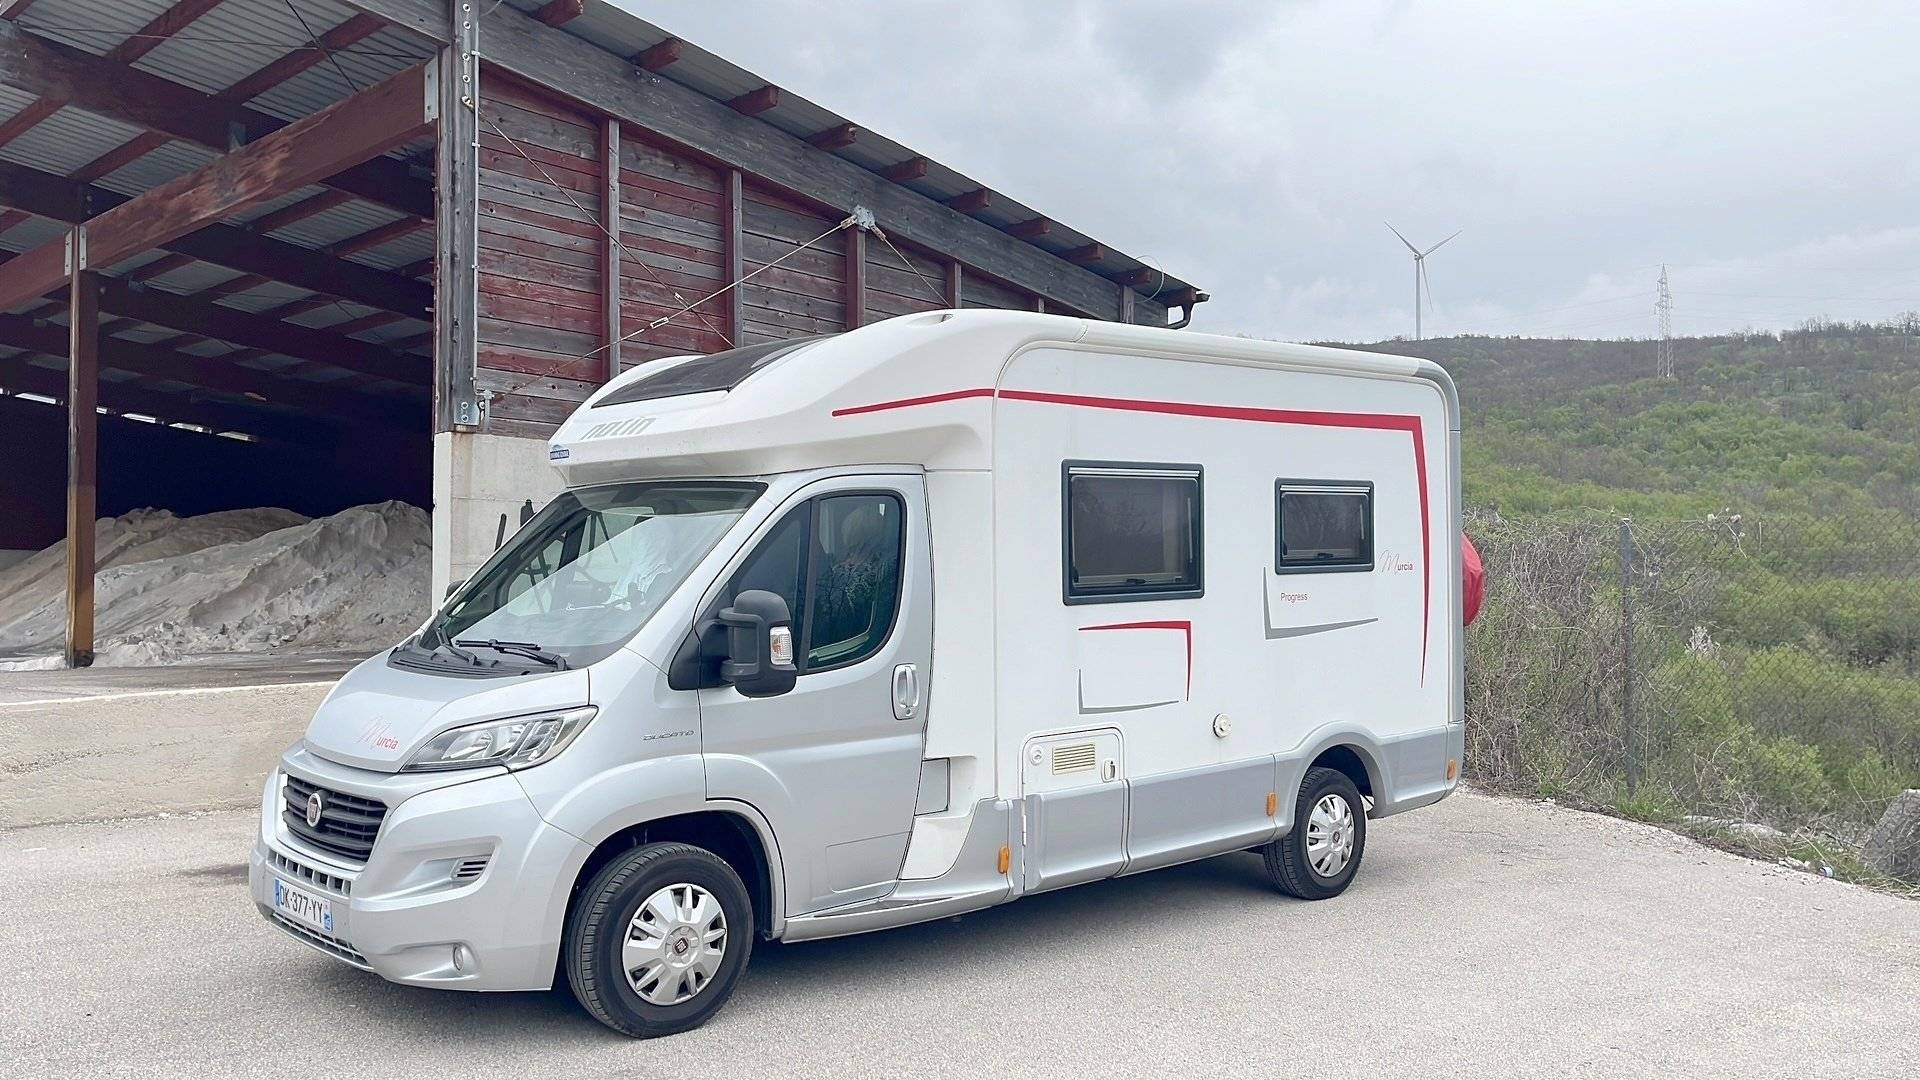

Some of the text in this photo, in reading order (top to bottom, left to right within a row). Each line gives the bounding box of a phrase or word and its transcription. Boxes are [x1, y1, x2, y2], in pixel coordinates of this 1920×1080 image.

[1379, 549, 1414, 573] Murcia
[1280, 592, 1308, 603] Progress
[357, 716, 399, 750] Murcia
[280, 885, 323, 923] DK-377-YY
